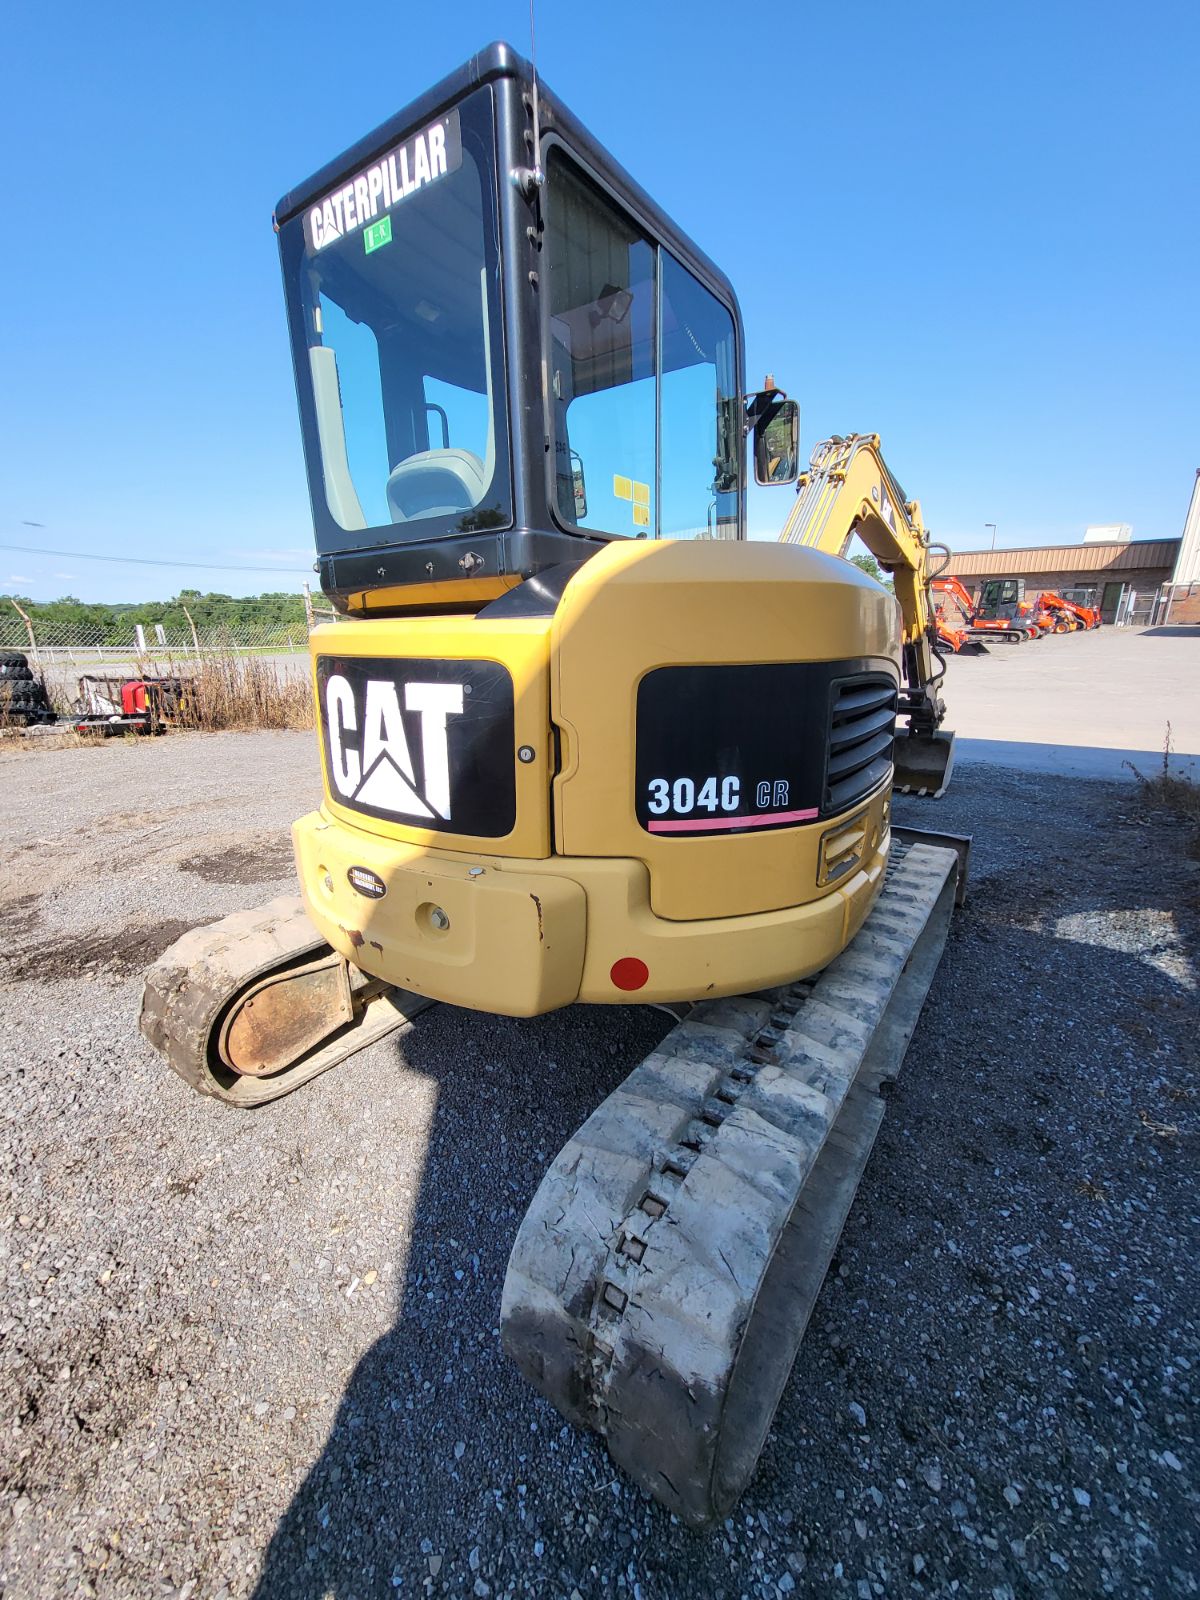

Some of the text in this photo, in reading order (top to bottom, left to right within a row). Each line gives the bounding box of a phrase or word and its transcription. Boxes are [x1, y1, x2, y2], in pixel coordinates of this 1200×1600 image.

[310, 124, 448, 250] CATERPILLAR
[326, 675, 464, 821] CAT
[648, 776, 790, 814] 304C CR
